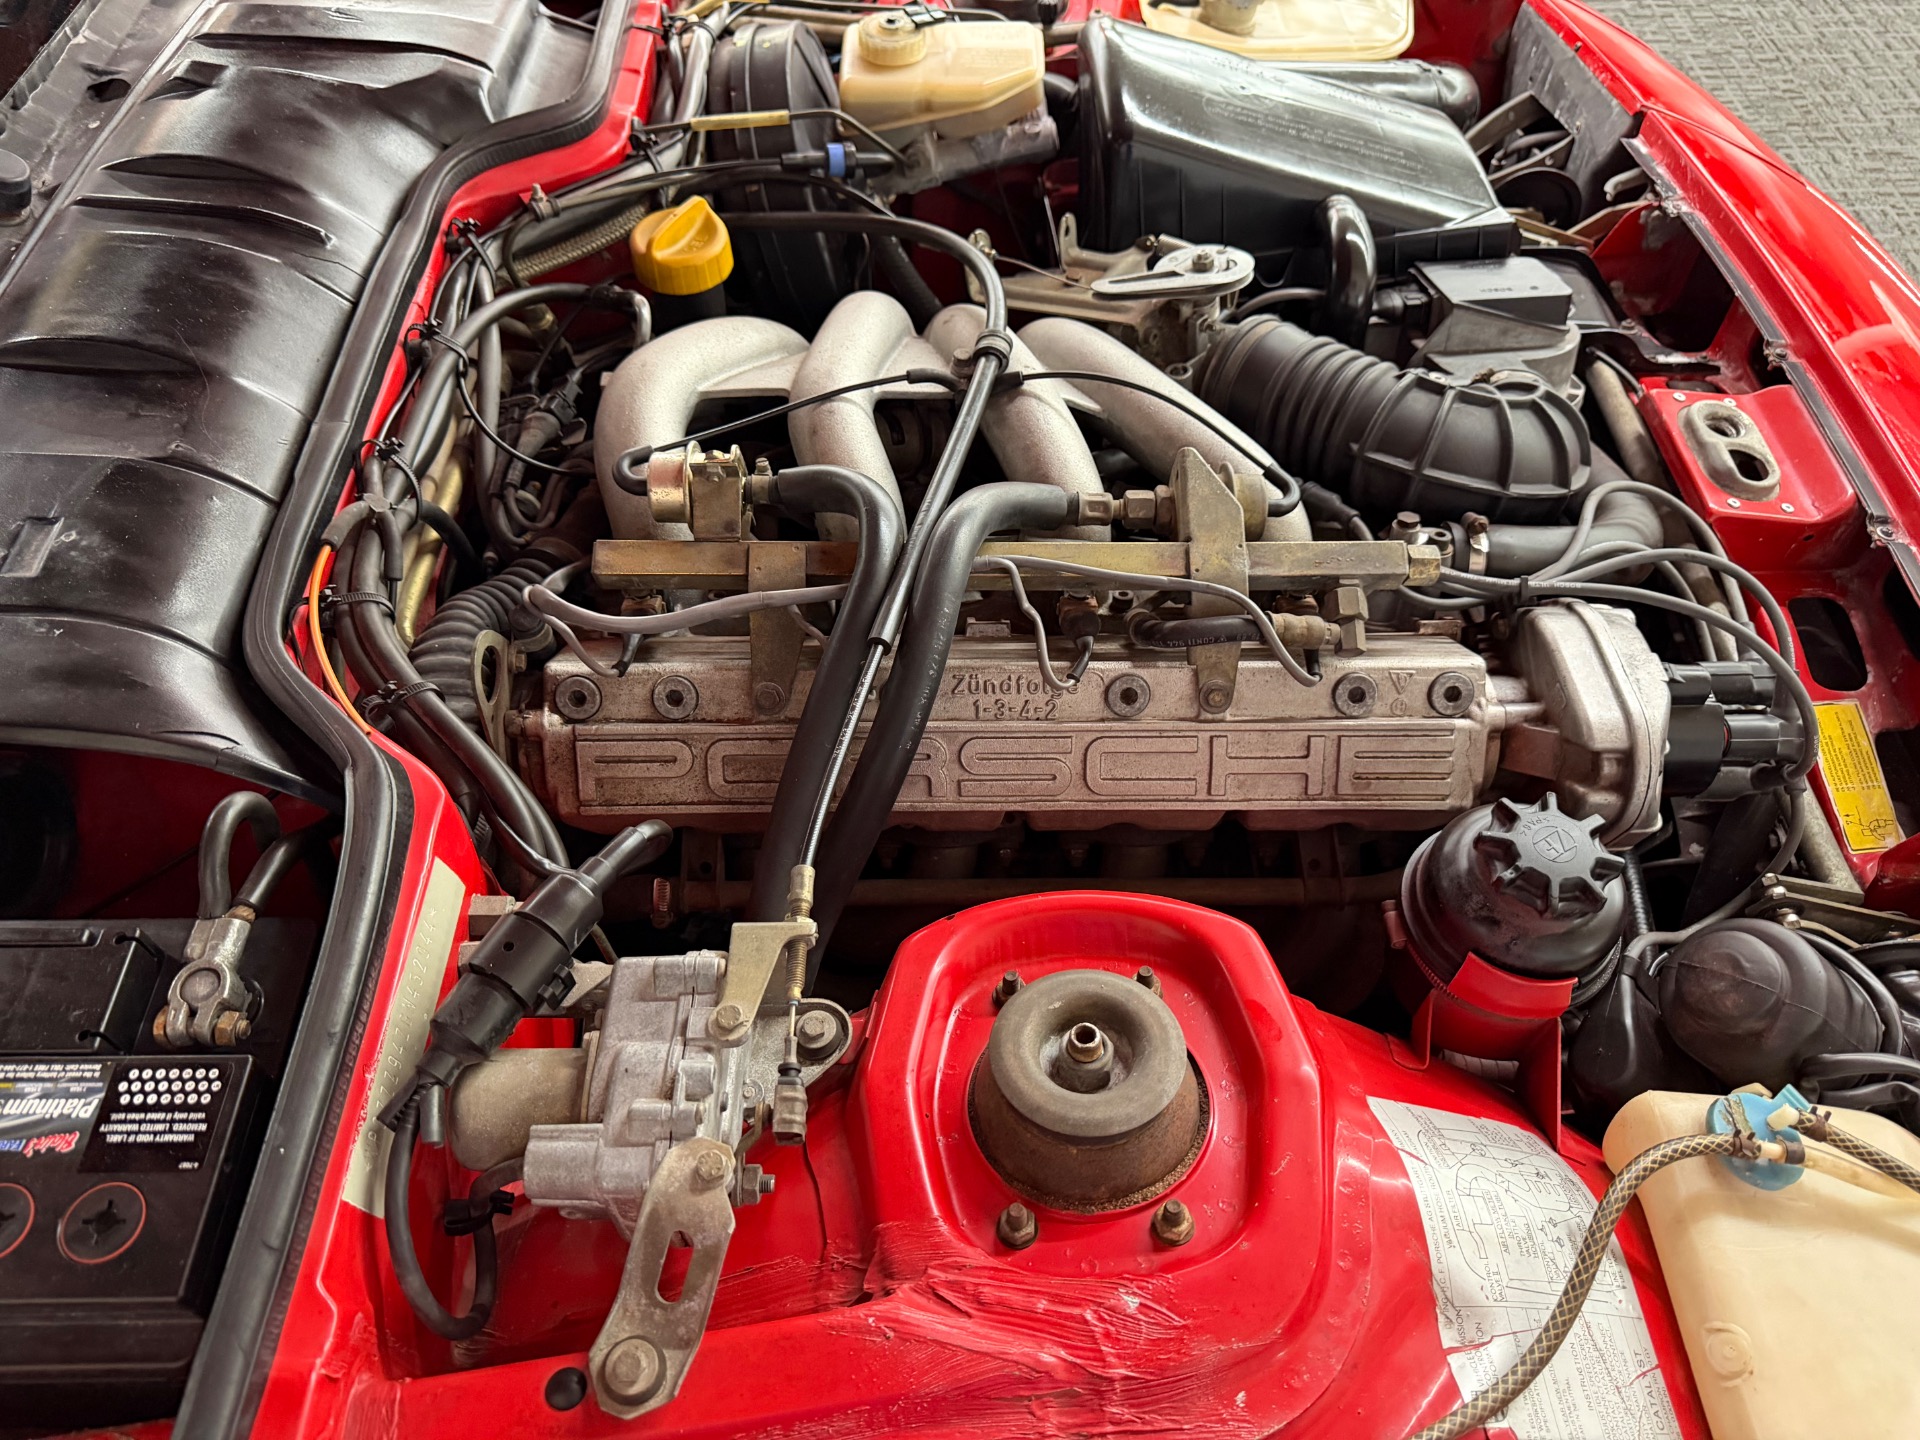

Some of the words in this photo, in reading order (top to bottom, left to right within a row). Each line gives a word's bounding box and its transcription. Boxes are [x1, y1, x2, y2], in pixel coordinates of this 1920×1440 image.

[1187, 636, 1214, 645] CONTI
[972, 699, 1059, 720] 1-3-4-2
[576, 731, 1455, 801] PORSCHE
[3, 1098, 99, 1117] Platinum
[126, 1111, 145, 1121] when
[145, 1111, 166, 1121] dated
[173, 1110, 188, 1121] only
[188, 1111, 205, 1121] valid
[98, 1122, 139, 1132] WARRANTY
[105, 1133, 127, 1143] LABEL
[127, 1134, 135, 1143] IF
[136, 1133, 154, 1142] VOID
[140, 1122, 170, 1132] LIMITED
[154, 1133, 195, 1143] WARRANTY
[171, 1122, 207, 1132] REMOVED.
[1432, 1191, 1443, 1212] HOSE
[1445, 1189, 1457, 1214] FILTER
[1484, 1189, 1497, 1214] METER
[1425, 1210, 1434, 1222] AG
[1453, 1215, 1461, 1228] AIR
[1493, 1216, 1504, 1238] FLOW
[1438, 1214, 1453, 1249] VACUUM
[1510, 1218, 1526, 1257] THROTTLE
[1523, 1222, 1538, 1259] HOUSING
[1428, 1223, 1443, 1264] PORSCHE
[1500, 1238, 1509, 1254] AIR
[1520, 1235, 1531, 1258] VALVE
[1539, 1240, 1553, 1279] CONTROL
[1483, 1260, 1497, 1300] CONTROL
[1494, 1276, 1505, 1301] VALVE
[1611, 1270, 1620, 1288] LINE
[1574, 1333, 1589, 1361] SCREW
[1596, 1321, 1616, 1372] RECONNECT
[1465, 1355, 1483, 1388] VEHICLE
[1568, 1341, 1594, 1411] INSTRUCTION
[1586, 1346, 1601, 1384] OXYGEN
[1593, 1354, 1610, 1396] MEASURE
[1564, 1376, 1578, 1412] NEUTRAL
[1632, 1347, 1666, 1432] CATALYST
[1597, 1408, 1611, 1439] ADJUST
[1606, 1398, 1624, 1440] CONTACT
